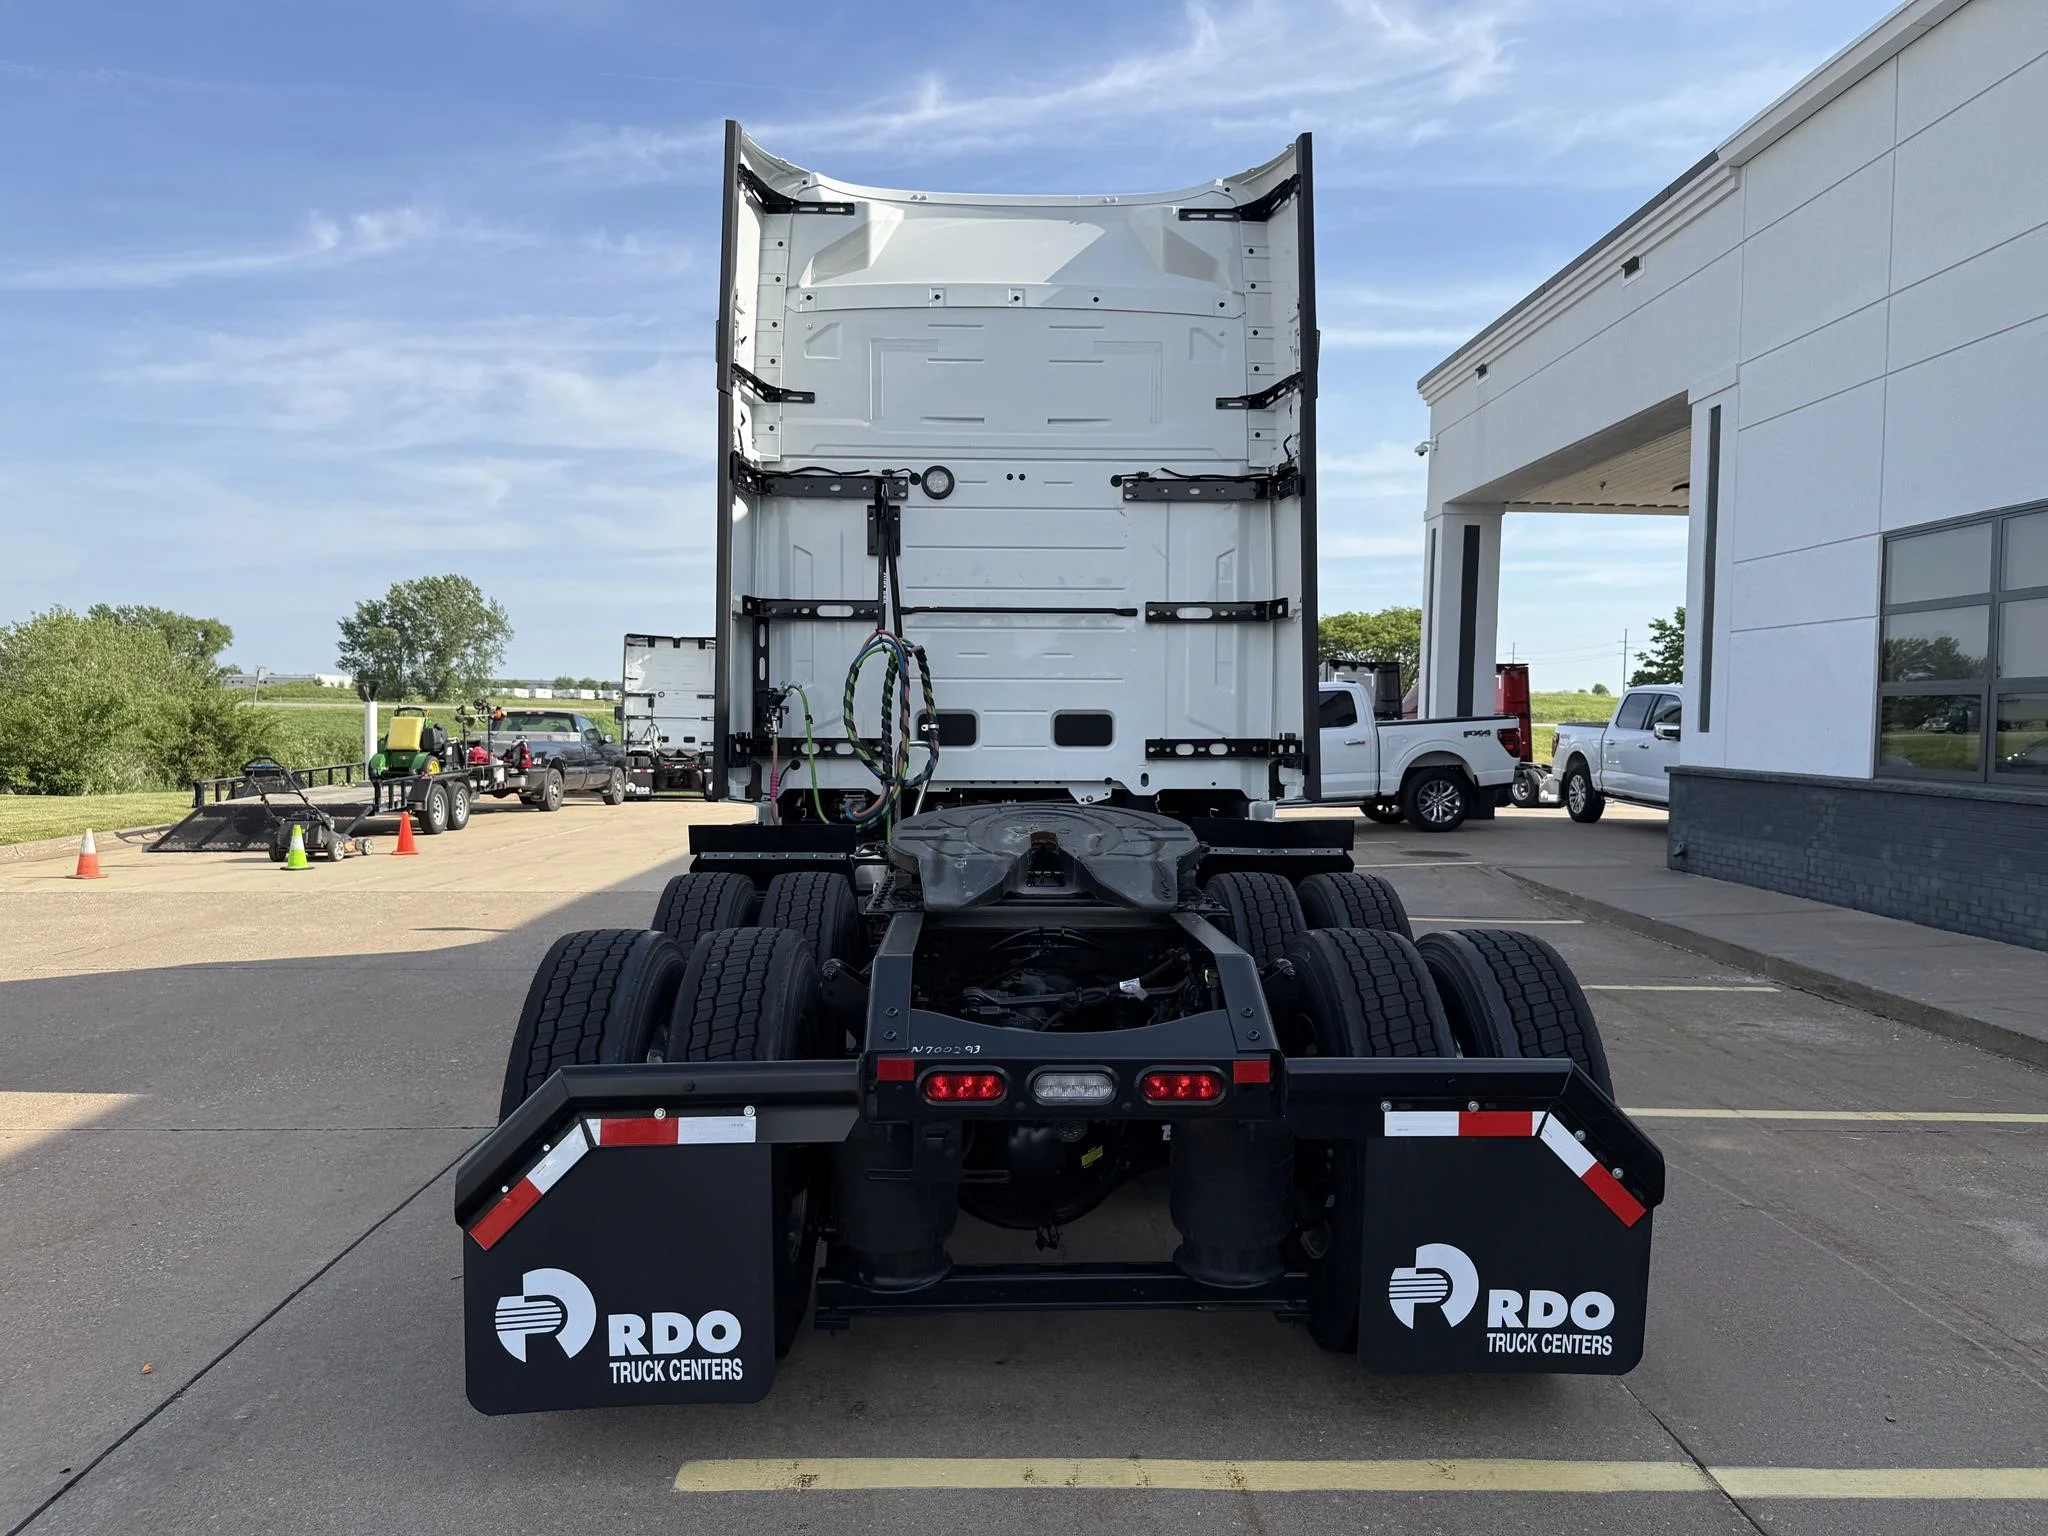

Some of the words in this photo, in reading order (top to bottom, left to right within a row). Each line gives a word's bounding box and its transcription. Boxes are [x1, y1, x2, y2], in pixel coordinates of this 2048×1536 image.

[1463, 730, 1491, 738] FX4
[1487, 1289, 1615, 1331] RDO
[608, 1310, 742, 1356] RDO
[1487, 1333, 1538, 1353] TRUCK
[1541, 1333, 1613, 1356] CENTERS
[609, 1360, 666, 1384] TRUCK
[669, 1358, 743, 1381] CENTERS
